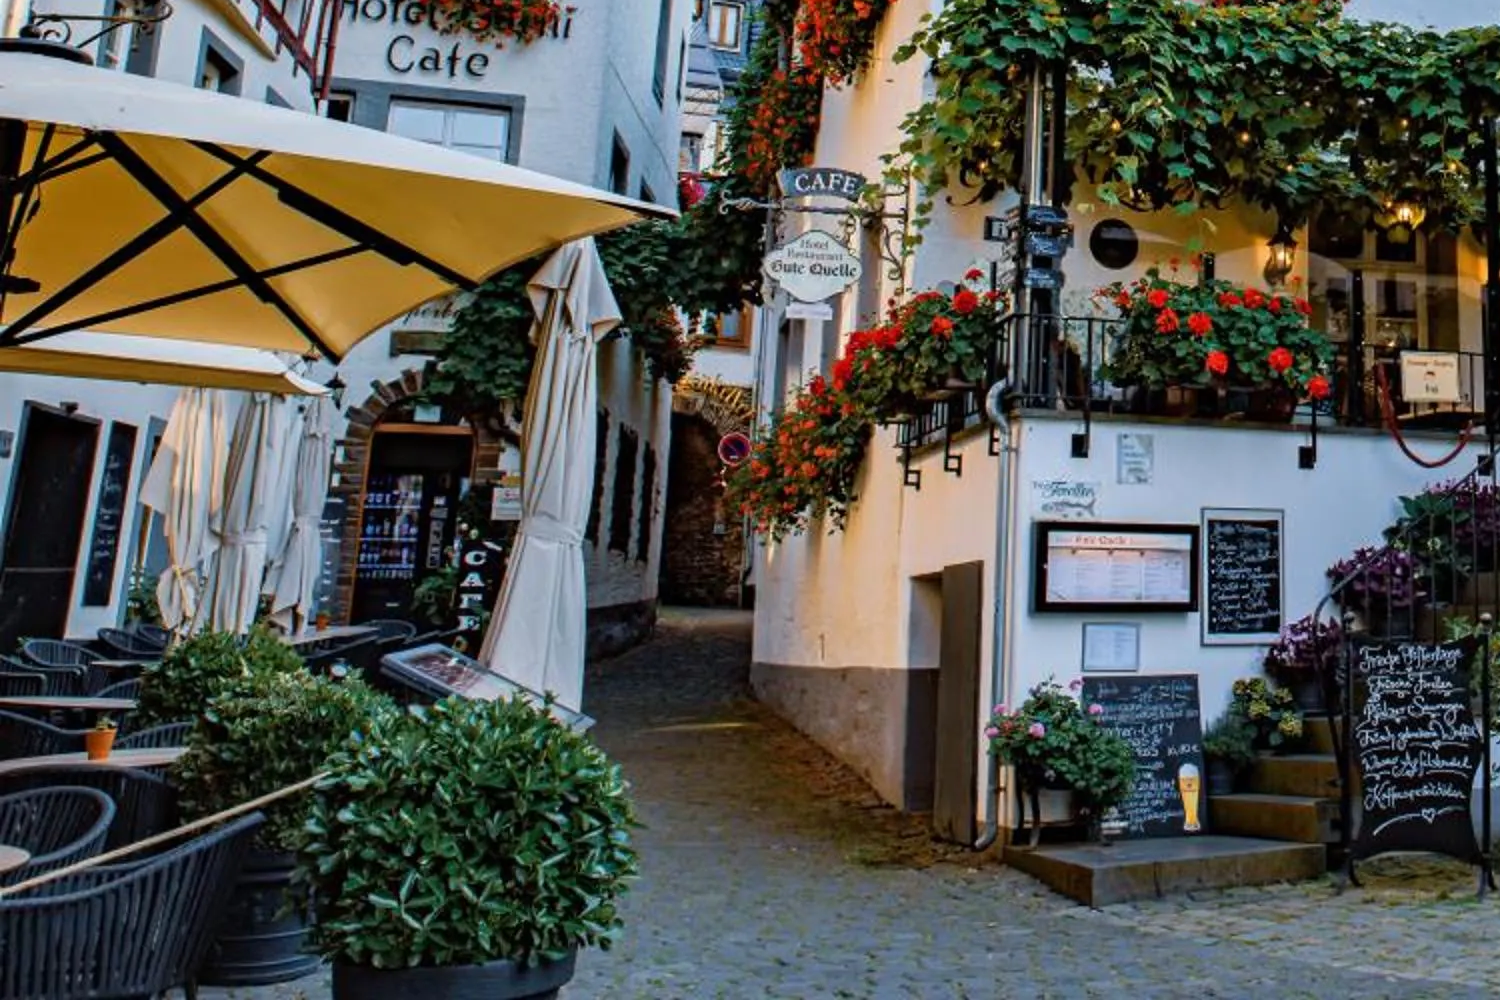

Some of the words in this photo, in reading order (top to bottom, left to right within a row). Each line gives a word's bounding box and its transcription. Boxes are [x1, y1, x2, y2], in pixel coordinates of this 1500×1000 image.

[386, 34, 490, 80] Cafe
[795, 172, 858, 195] CAFE
[799, 239, 830, 250] Hotel
[787, 248, 844, 261] Restaurant
[771, 259, 806, 276] Gute
[809, 262, 858, 278] Quelle
